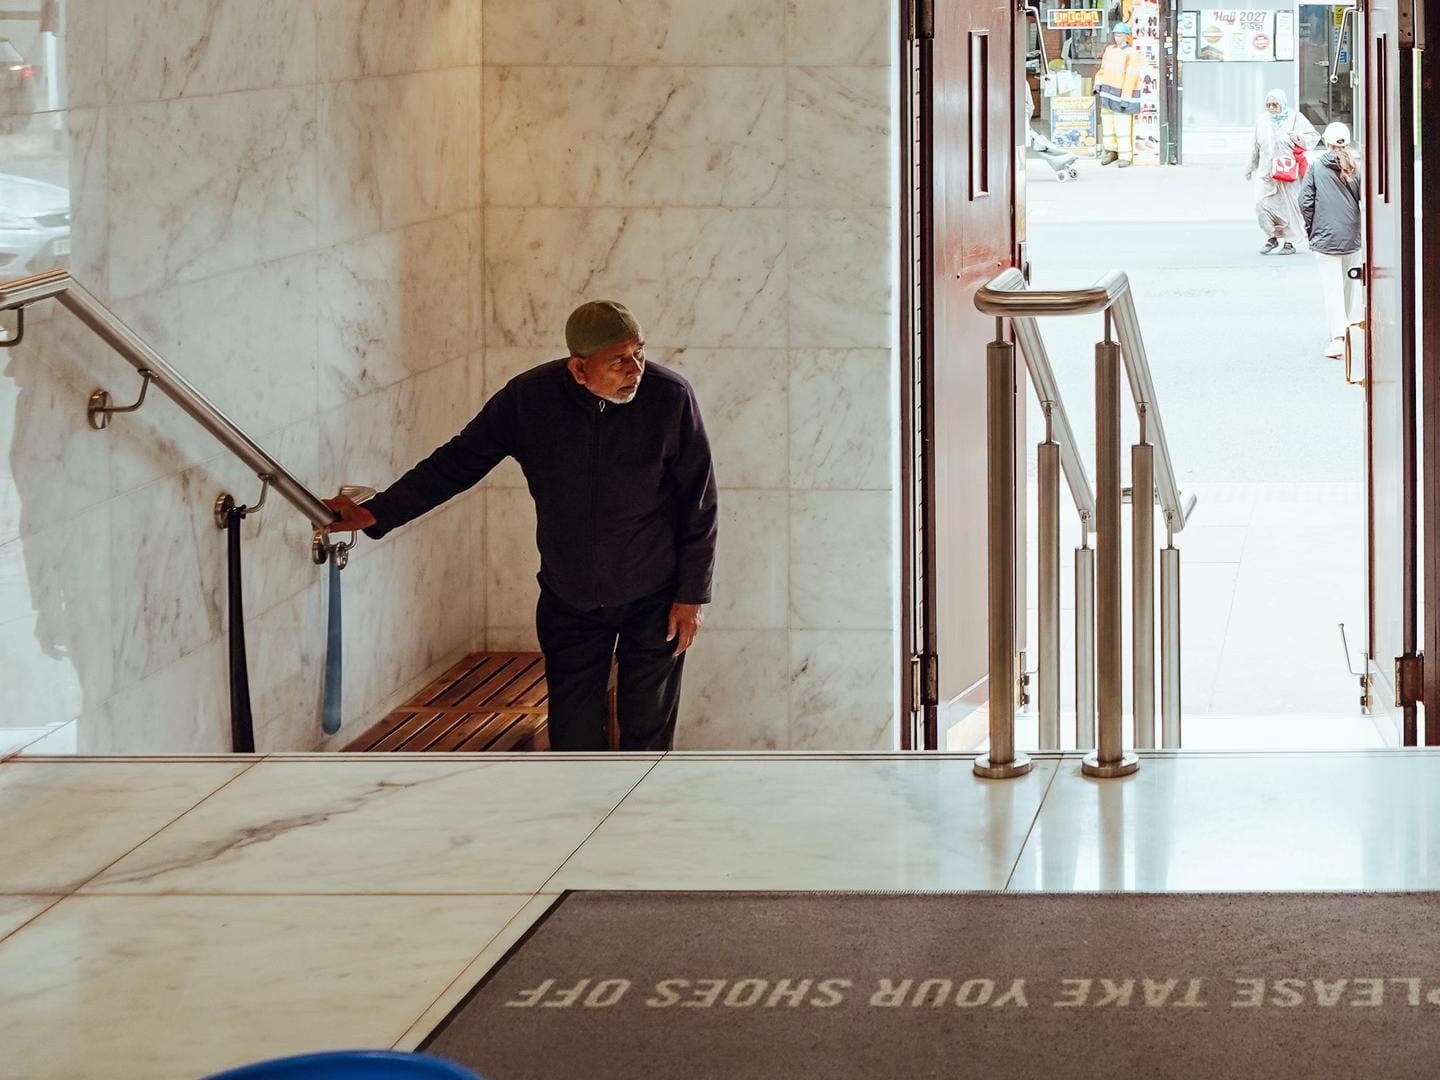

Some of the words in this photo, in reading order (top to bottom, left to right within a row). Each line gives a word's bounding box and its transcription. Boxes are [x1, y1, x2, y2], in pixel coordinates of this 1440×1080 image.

[1053, 11, 1100, 23] SPECIAL
[1214, 11, 1237, 25] Hajj
[1240, 11, 1267, 22] 2027
[505, 978, 633, 1009] OFF
[645, 977, 853, 1008] SHOES
[869, 977, 1030, 1008] YOUR
[1053, 977, 1208, 1008] TAKE
